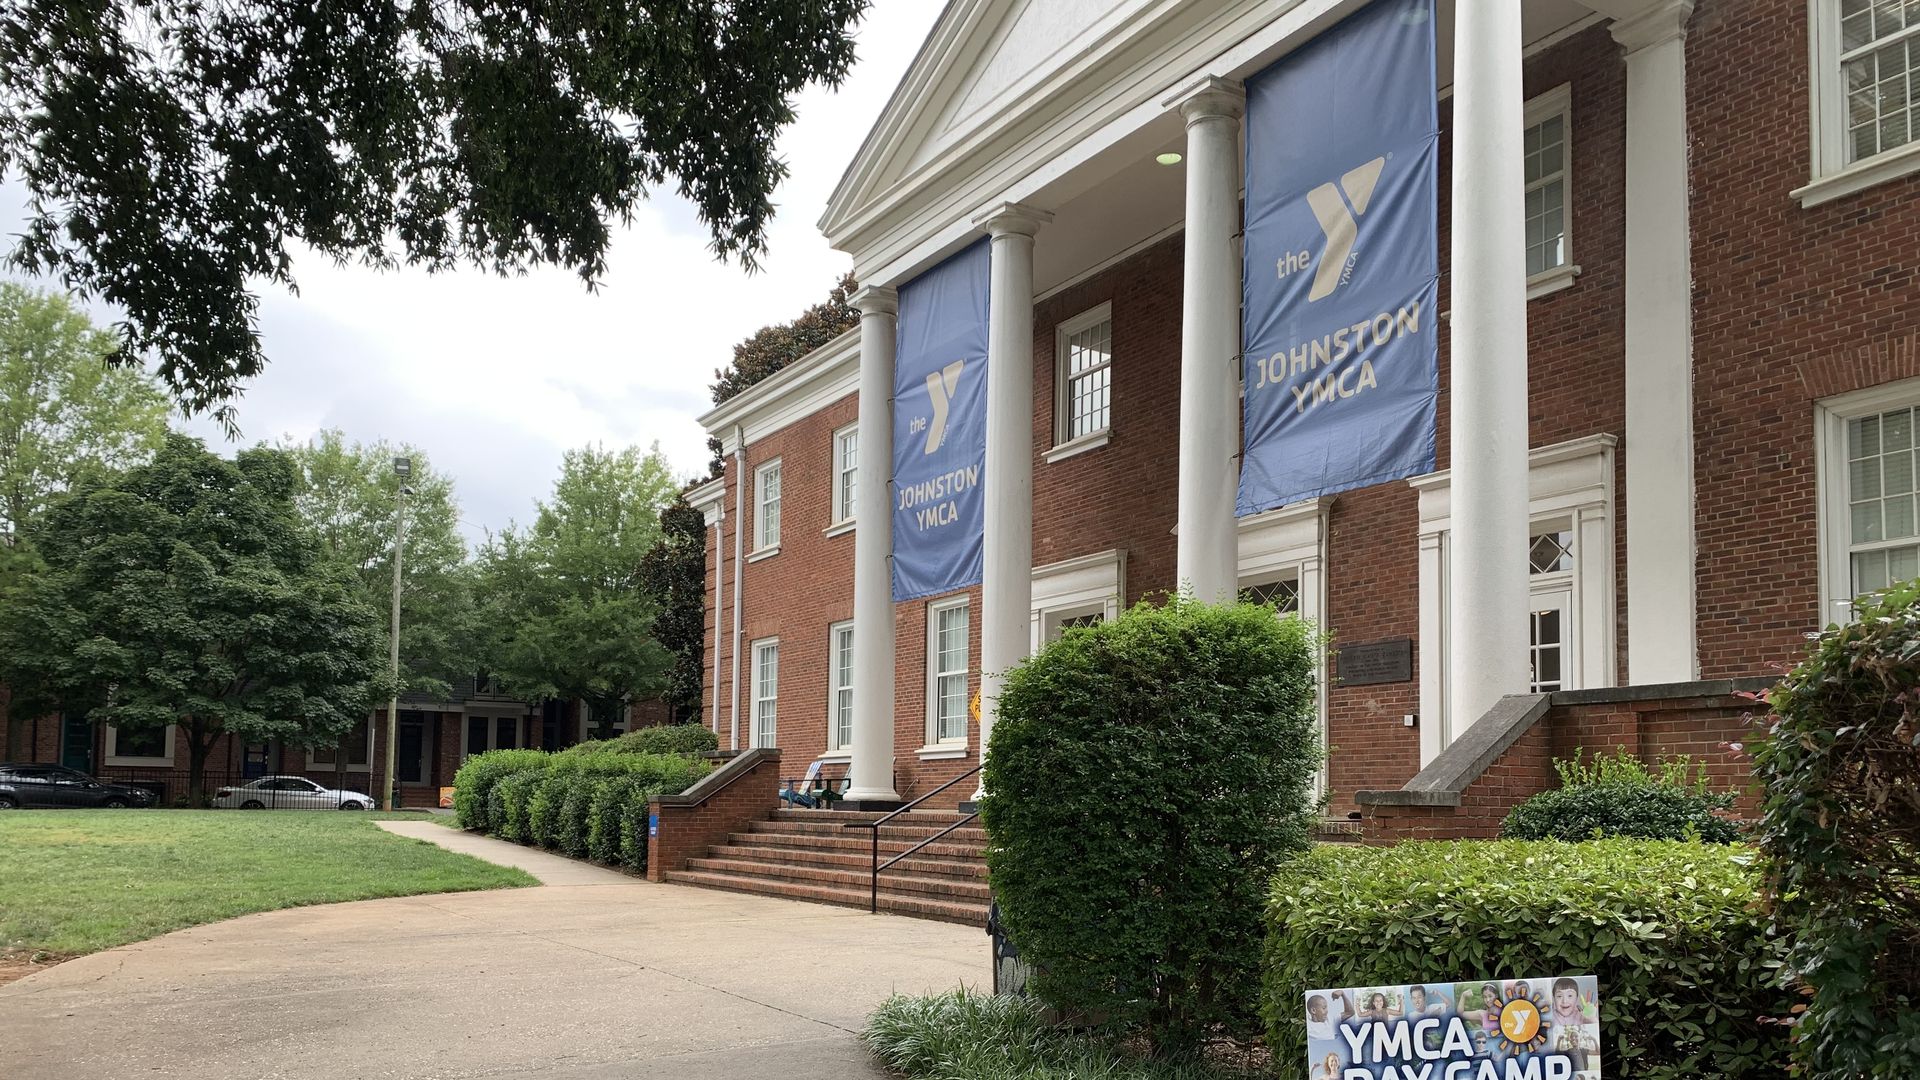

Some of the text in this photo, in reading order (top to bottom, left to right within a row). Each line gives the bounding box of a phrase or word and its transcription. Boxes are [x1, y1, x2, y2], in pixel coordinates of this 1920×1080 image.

[1277, 250, 1310, 279] the
[1340, 252, 1358, 286] YMCA
[1256, 302, 1420, 389] JOHNSTON
[1291, 359, 1378, 414] YMCA
[910, 416, 926, 434] the
[899, 465, 978, 510] JOHNSTON
[916, 500, 959, 531] YMCA
[1340, 1016, 1474, 1064] YMCA
